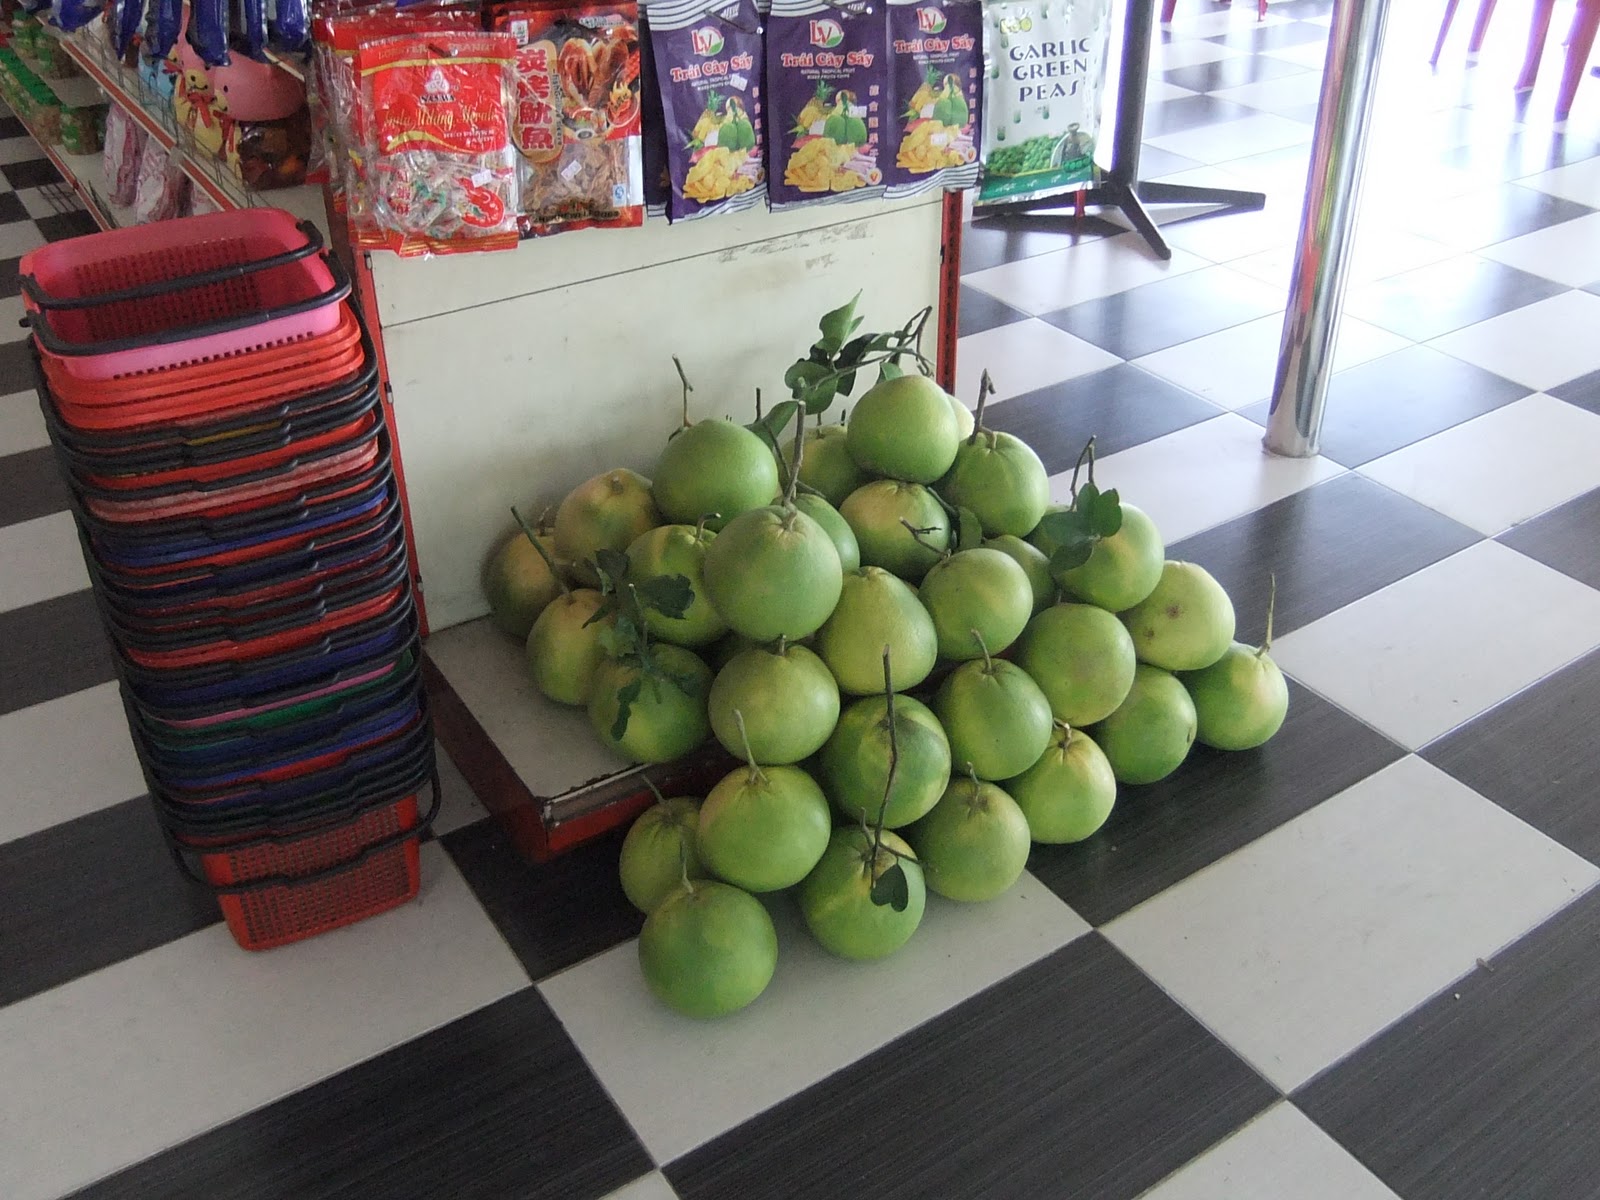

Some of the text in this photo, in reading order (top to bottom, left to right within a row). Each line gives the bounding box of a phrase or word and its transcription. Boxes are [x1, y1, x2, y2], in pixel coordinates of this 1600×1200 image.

[893, 33, 975, 54] Trái Cây Sấy
[1010, 37, 1090, 61] GARLIC
[670, 51, 753, 82] Trái Cây Sấy
[781, 48, 874, 68] Trái Cây Sấy
[1013, 58, 1087, 81] GREEN
[1019, 79, 1079, 102] PEAS
